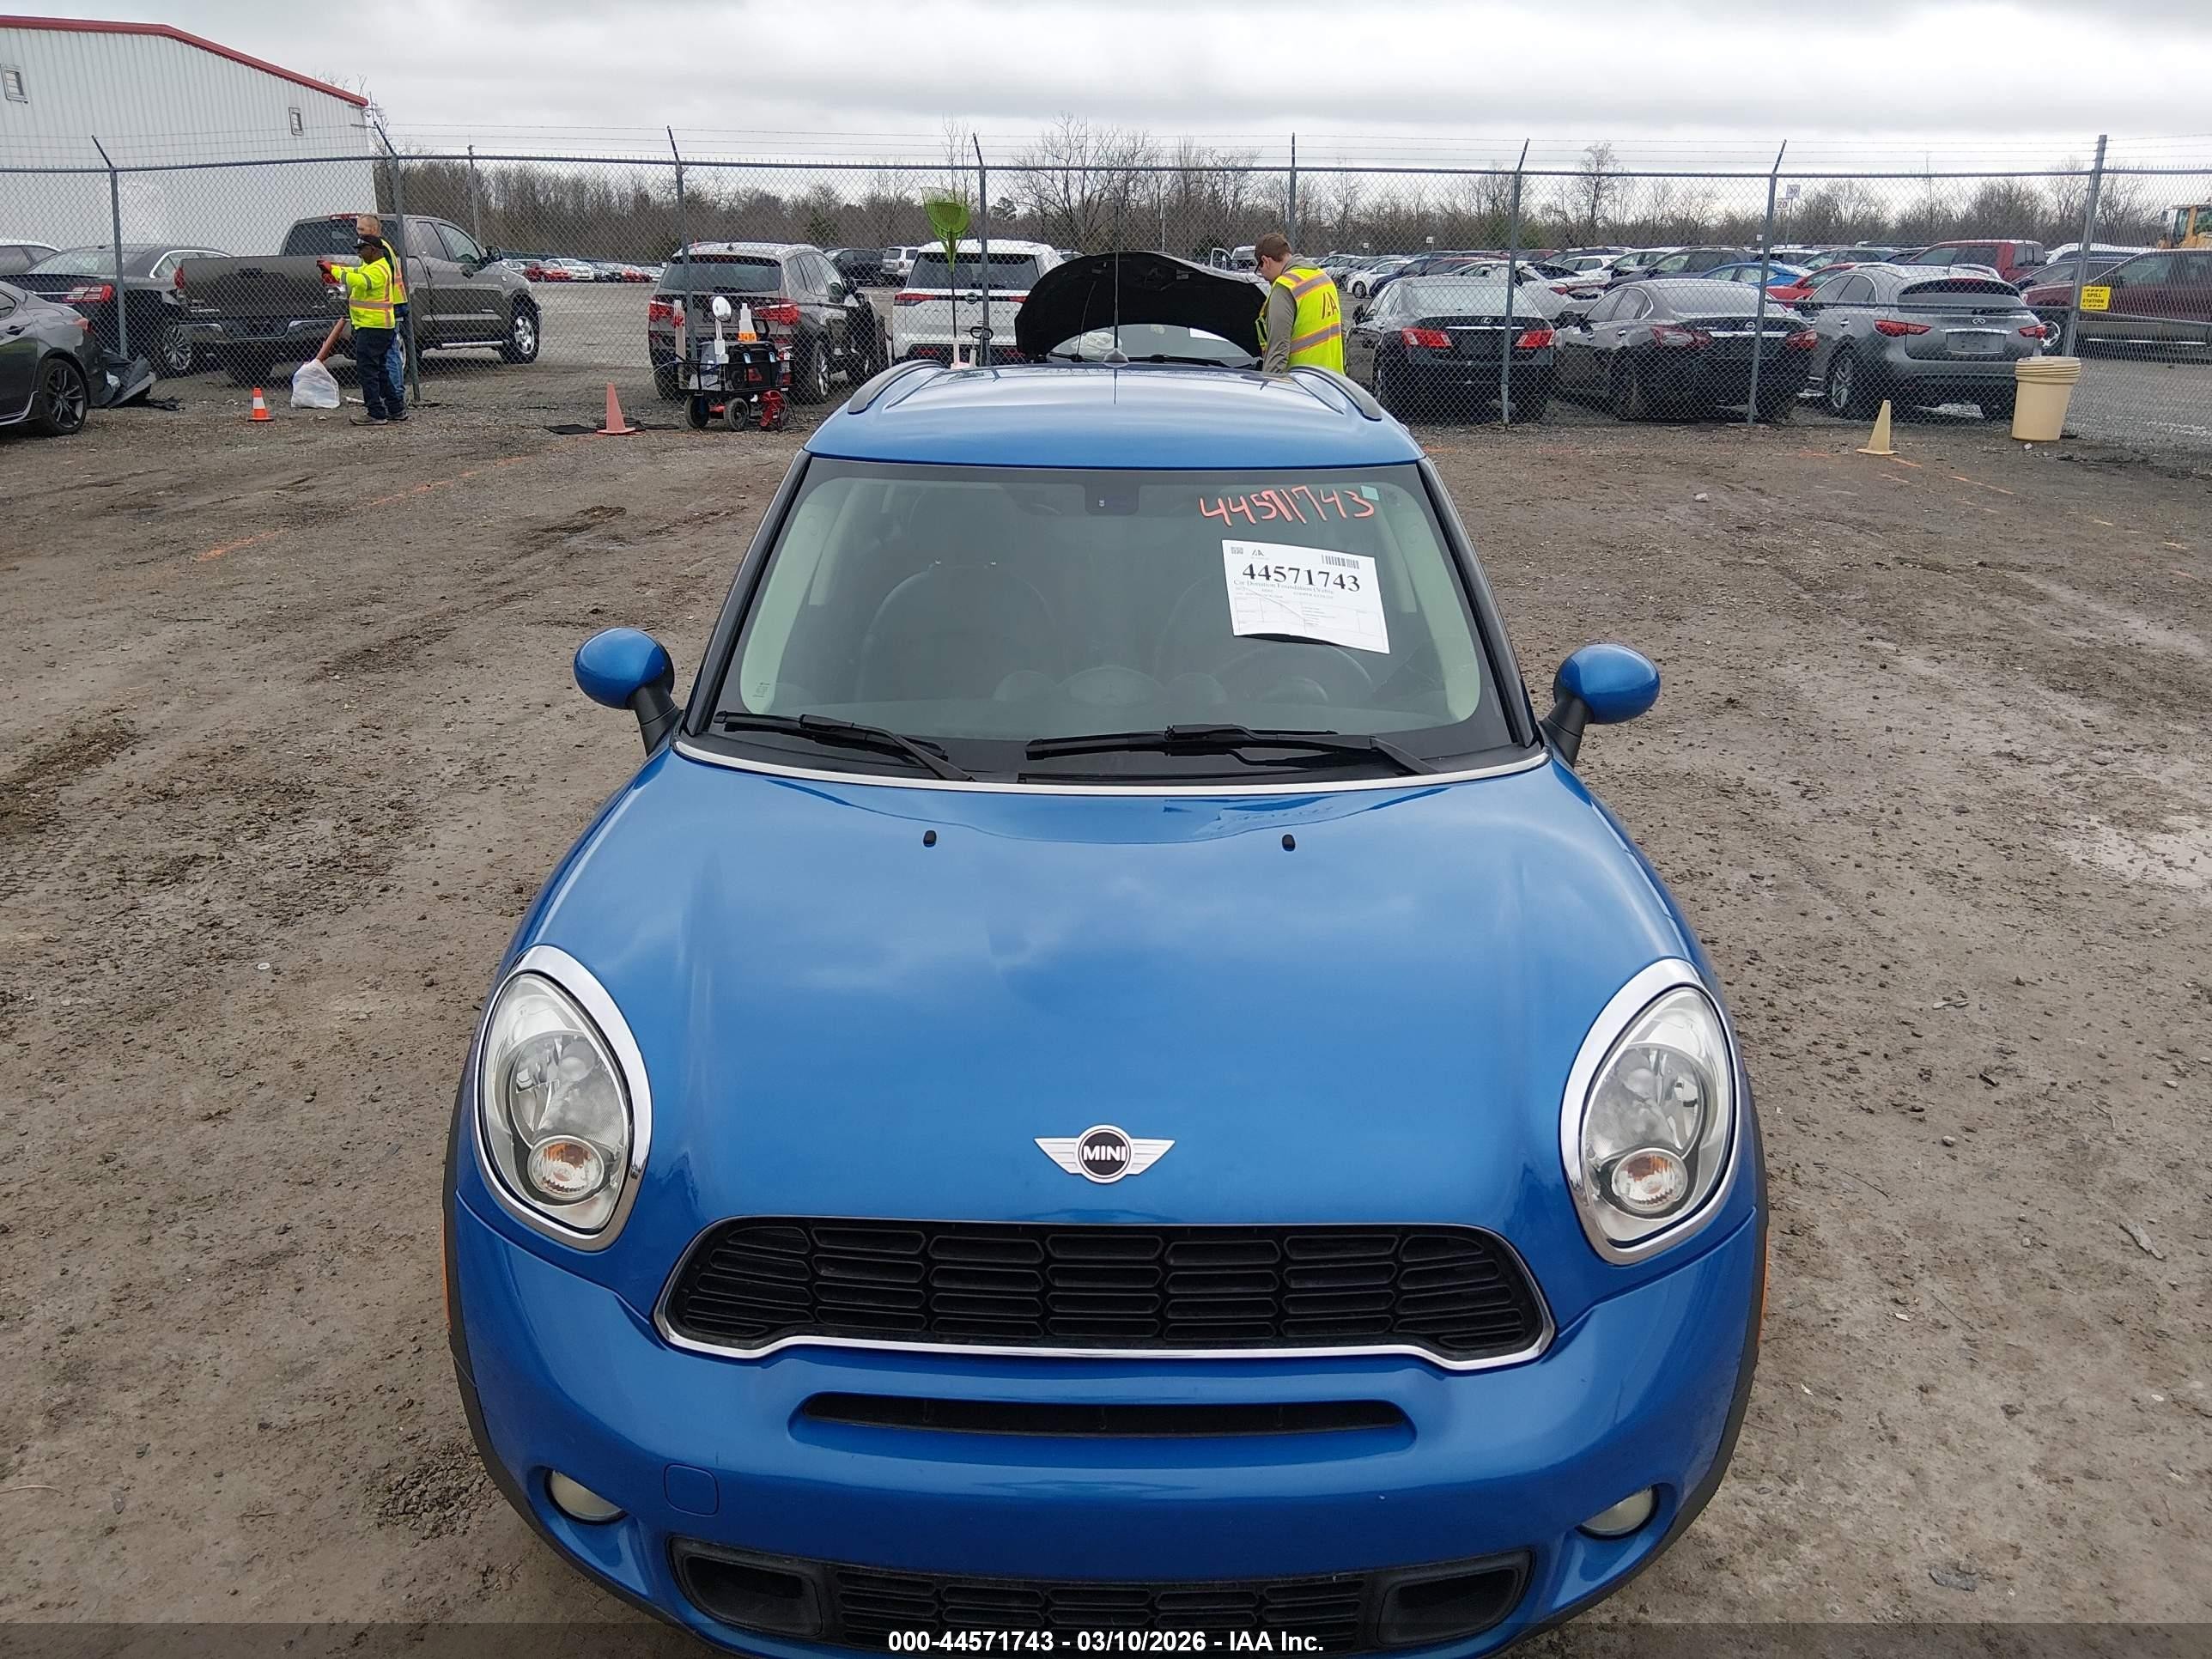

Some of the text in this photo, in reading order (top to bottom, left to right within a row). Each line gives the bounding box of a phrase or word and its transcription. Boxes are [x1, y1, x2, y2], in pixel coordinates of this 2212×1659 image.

[1199, 485, 1376, 527] 44571743
[1242, 562, 1361, 592] 44571743
[1083, 1145, 1127, 1162] MINI
